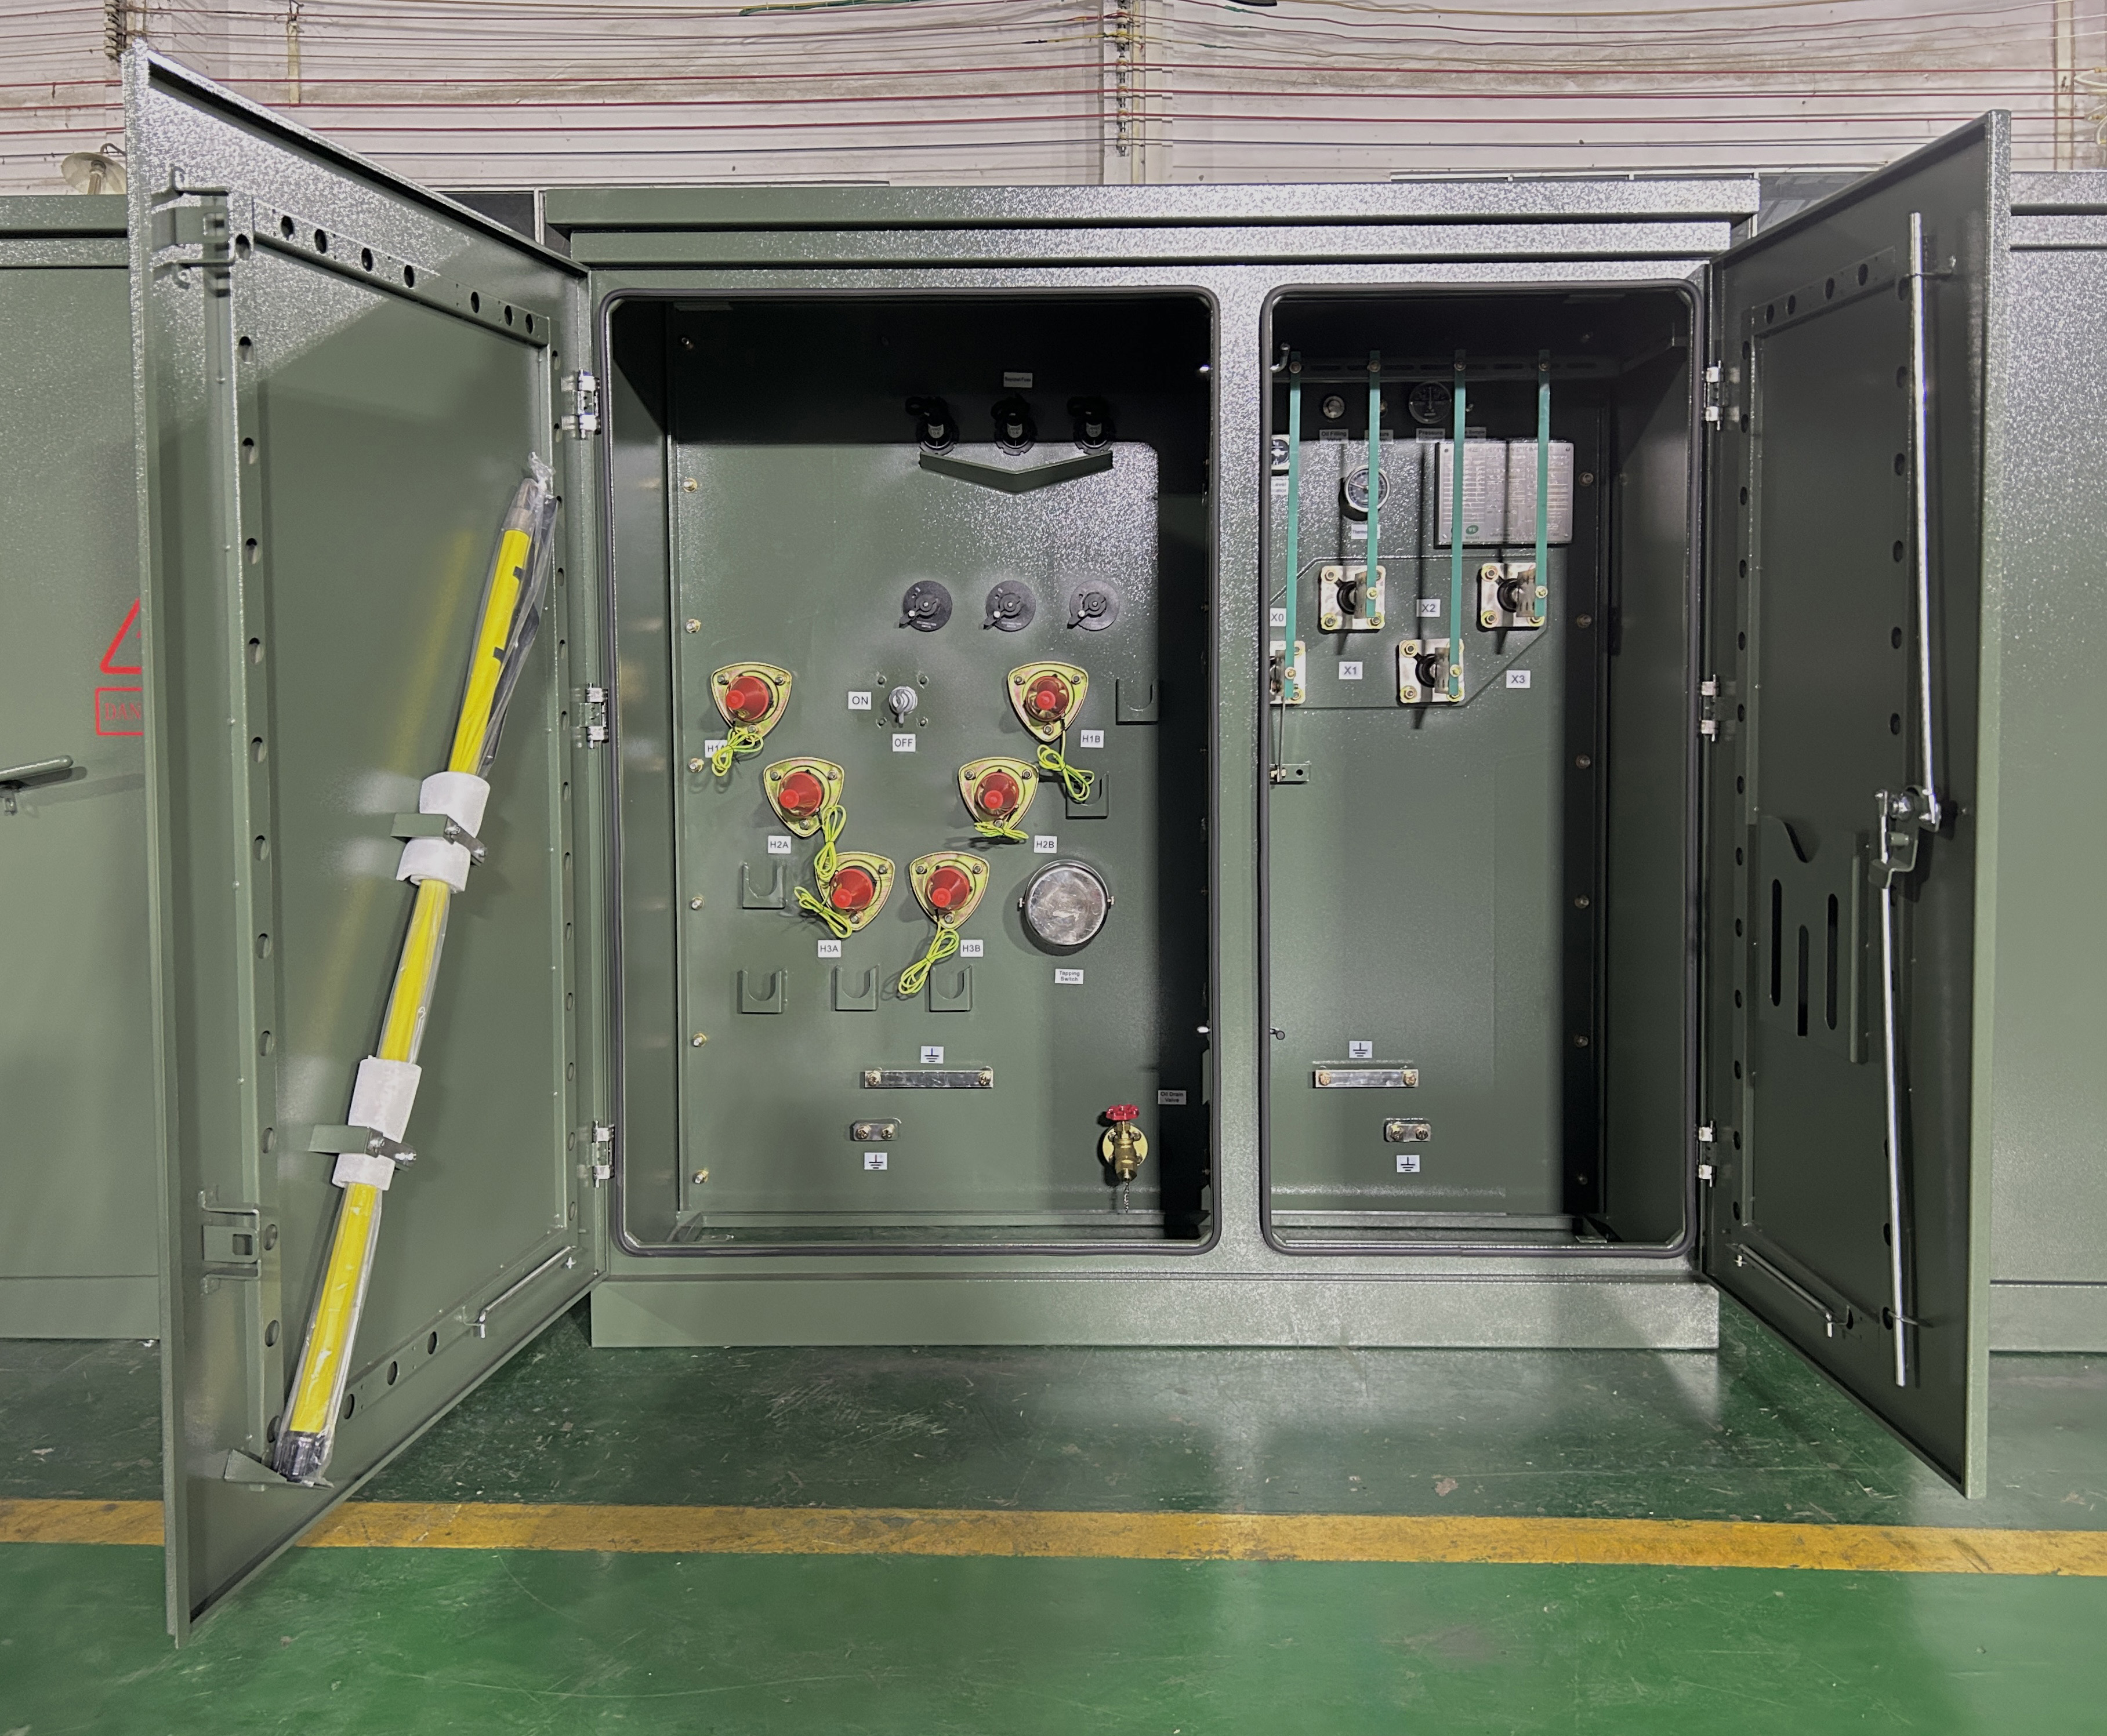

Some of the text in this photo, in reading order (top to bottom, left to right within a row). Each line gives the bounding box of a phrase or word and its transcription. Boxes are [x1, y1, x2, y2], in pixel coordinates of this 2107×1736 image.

[1421, 604, 1436, 613] X2
[1271, 613, 1284, 622] X0
[1343, 666, 1357, 675] X1
[1511, 675, 1526, 684] X3
[852, 696, 868, 705] ON
[104, 702, 142, 721] DAN
[894, 738, 913, 747] OFF
[1082, 735, 1101, 743] H1B
[770, 841, 789, 849] H2A
[820, 945, 839, 953] H3A
[963, 945, 980, 953] H3B
